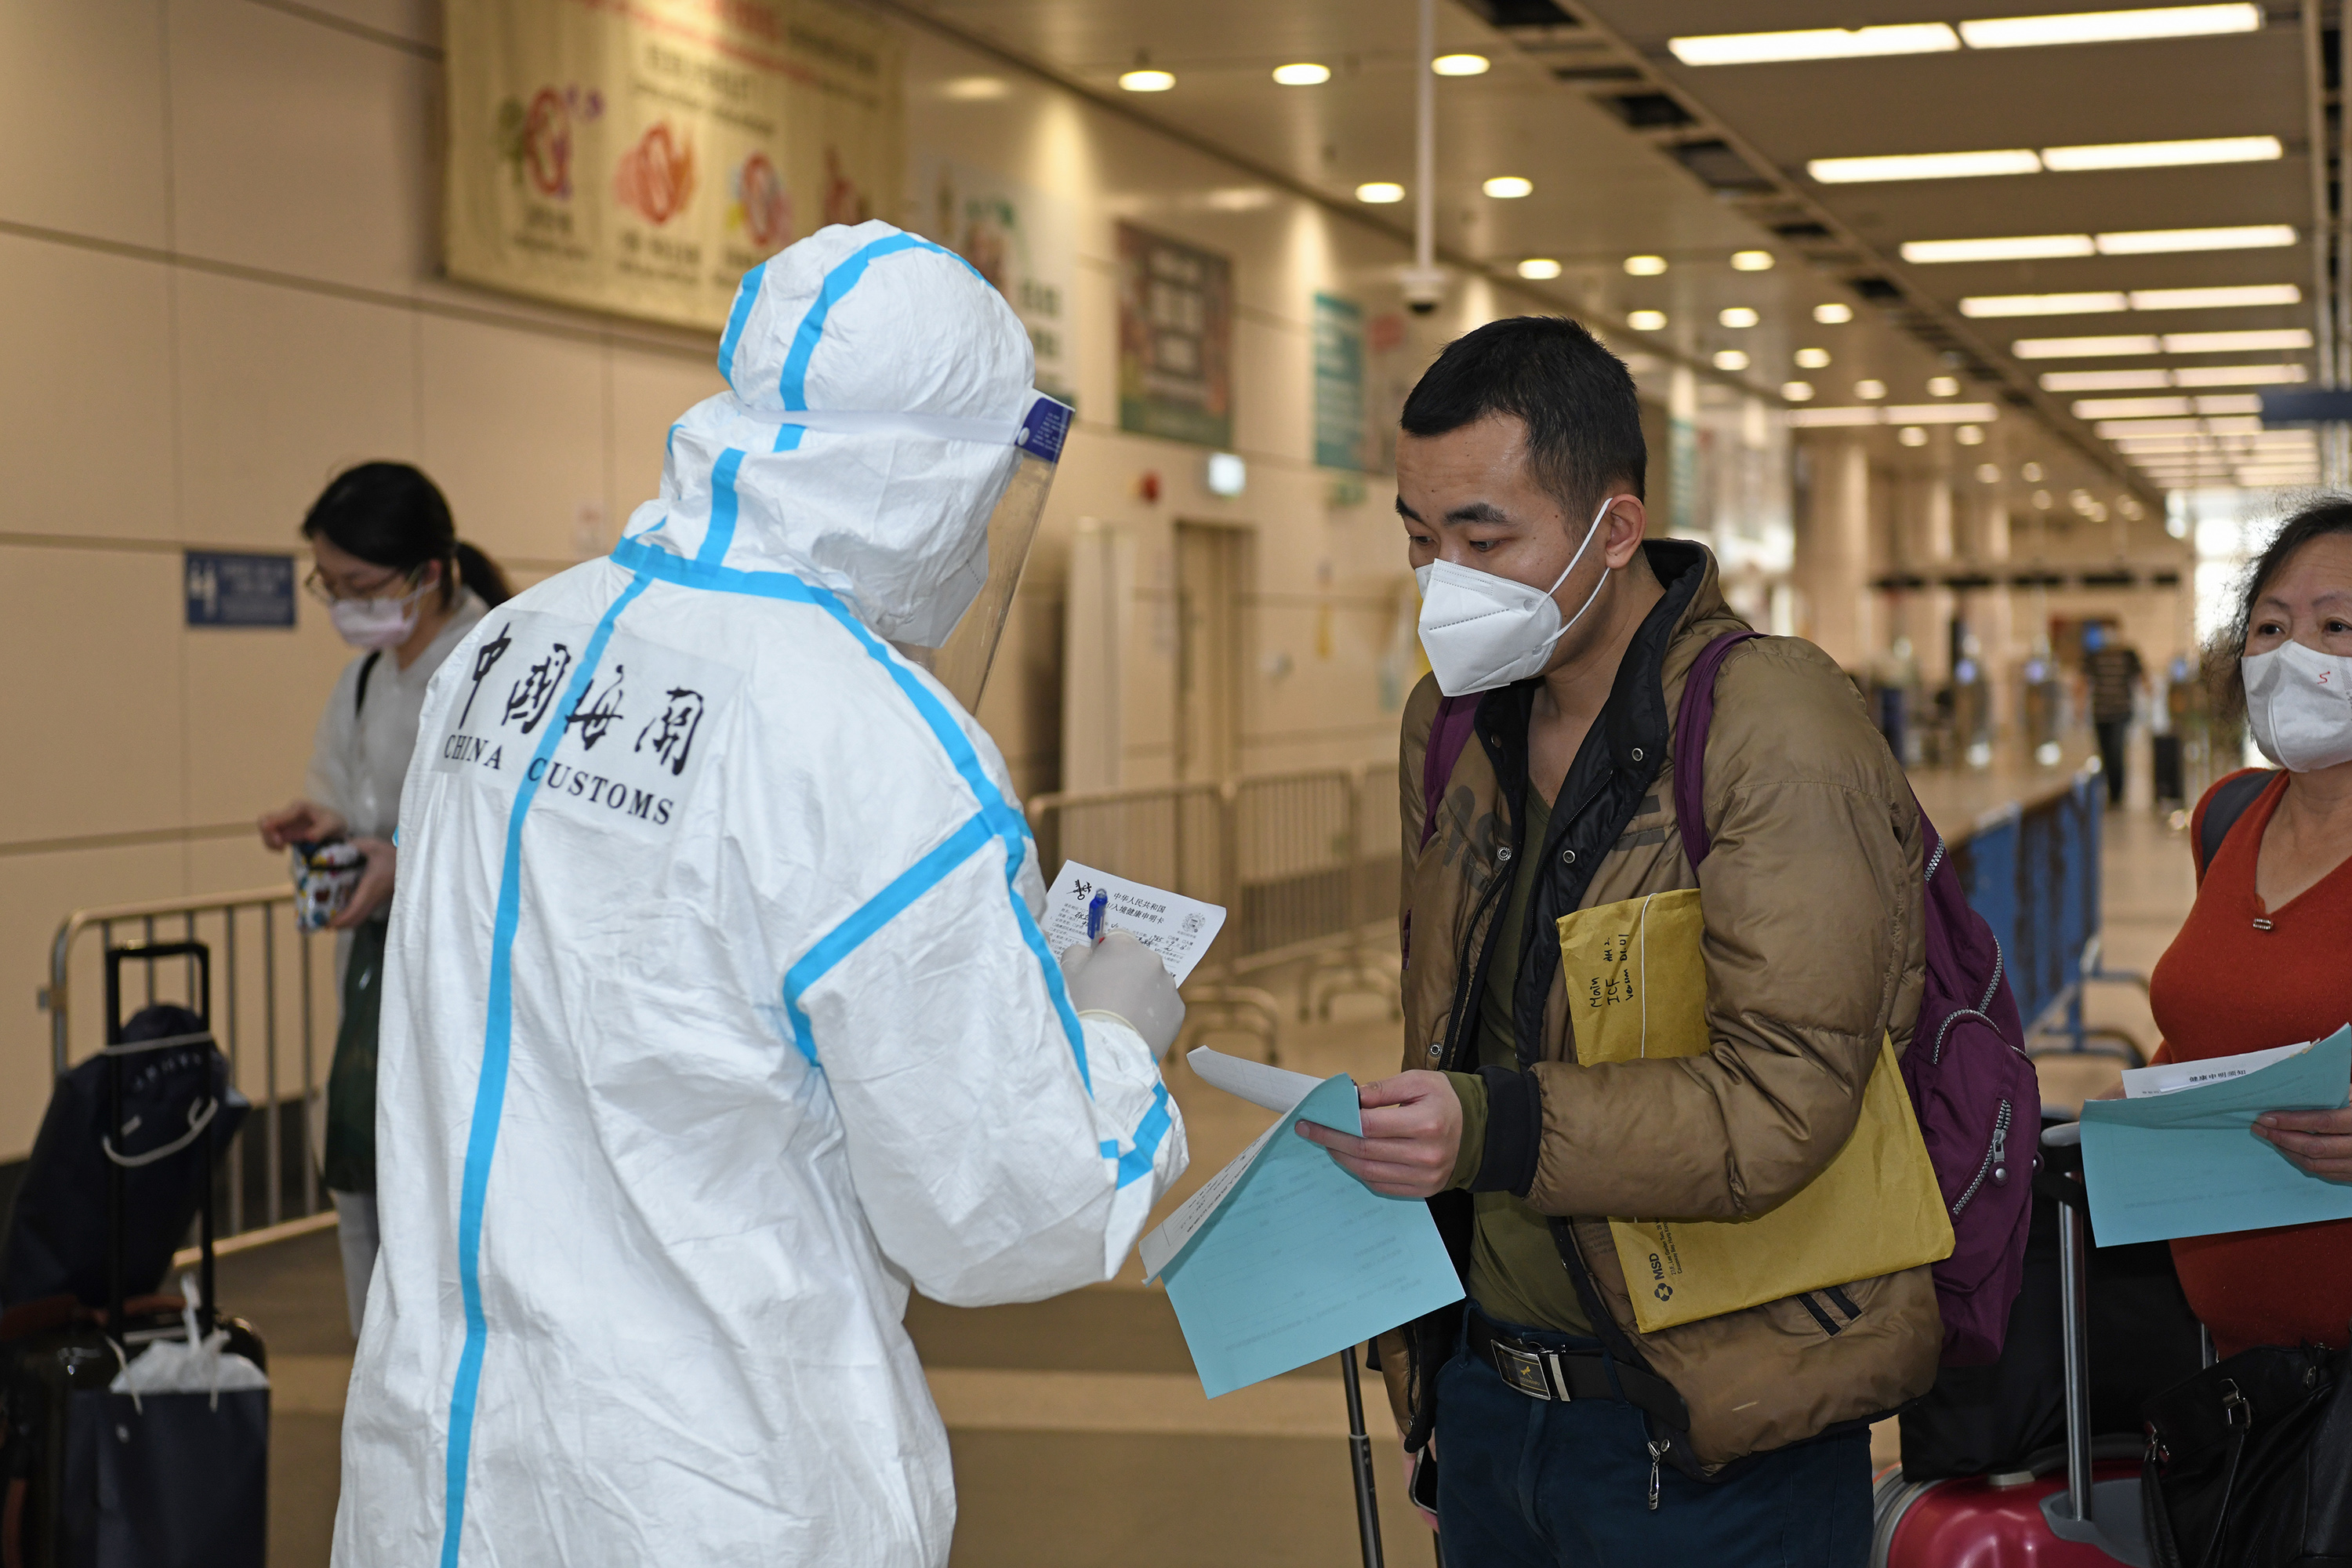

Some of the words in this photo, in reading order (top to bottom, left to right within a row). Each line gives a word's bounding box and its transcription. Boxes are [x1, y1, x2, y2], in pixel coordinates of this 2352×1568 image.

[444, 734, 504, 770] CHINA
[527, 757, 674, 825] CUSTOMS
[1113, 892, 1167, 914] 中华人民共和国
[1590, 977, 1602, 1007] Main
[1606, 978, 1620, 1005] ICF
[1662, 1241, 1671, 1256] Garden
[1649, 1253, 1665, 1280] MSD
[1674, 1253, 1682, 1274] Causeway
